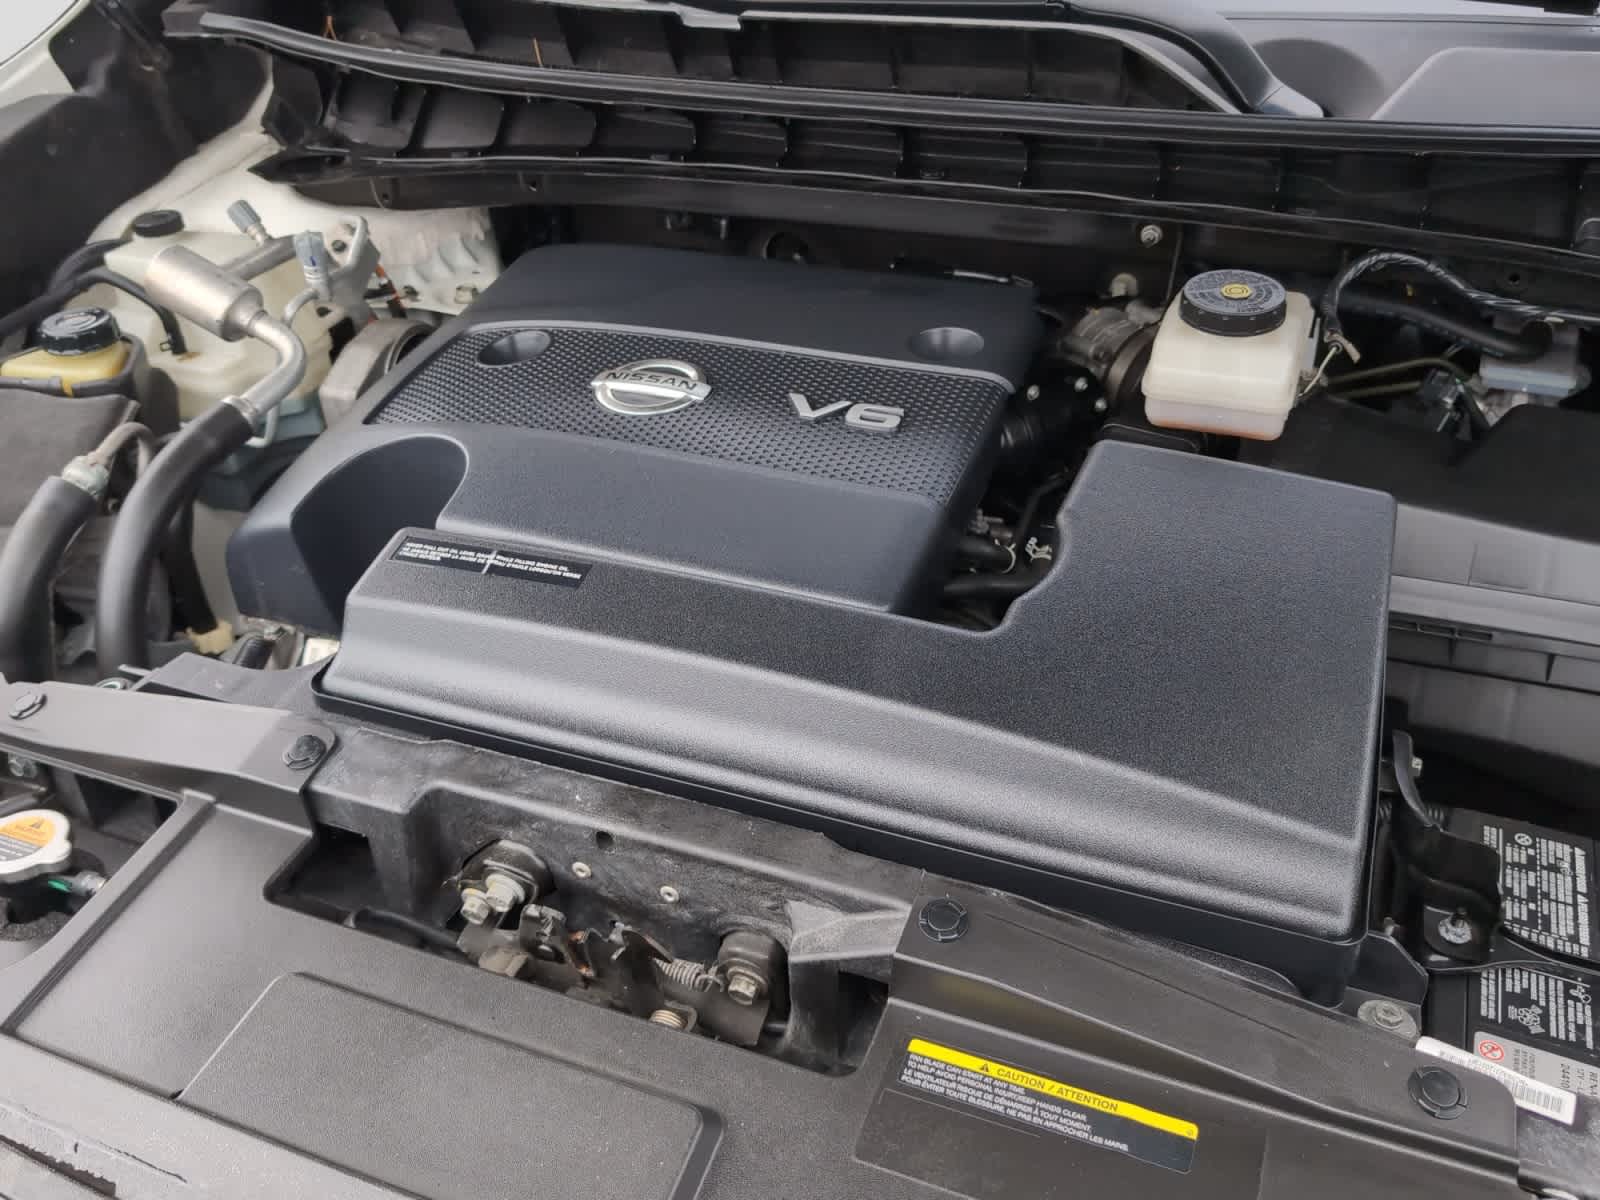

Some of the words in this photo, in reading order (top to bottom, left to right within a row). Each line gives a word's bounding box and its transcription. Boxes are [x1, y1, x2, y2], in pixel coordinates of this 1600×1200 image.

[606, 371, 697, 390] NISSAN
[788, 392, 904, 431] V6
[900, 1075, 921, 1086] POUR
[945, 1088, 968, 1101] TOUTE
[993, 1080, 1008, 1089] ANY
[996, 1067, 1046, 1089] CAUTION
[1056, 1087, 1119, 1112] ATTENTION
[1040, 1110, 1058, 1121] TOUT
